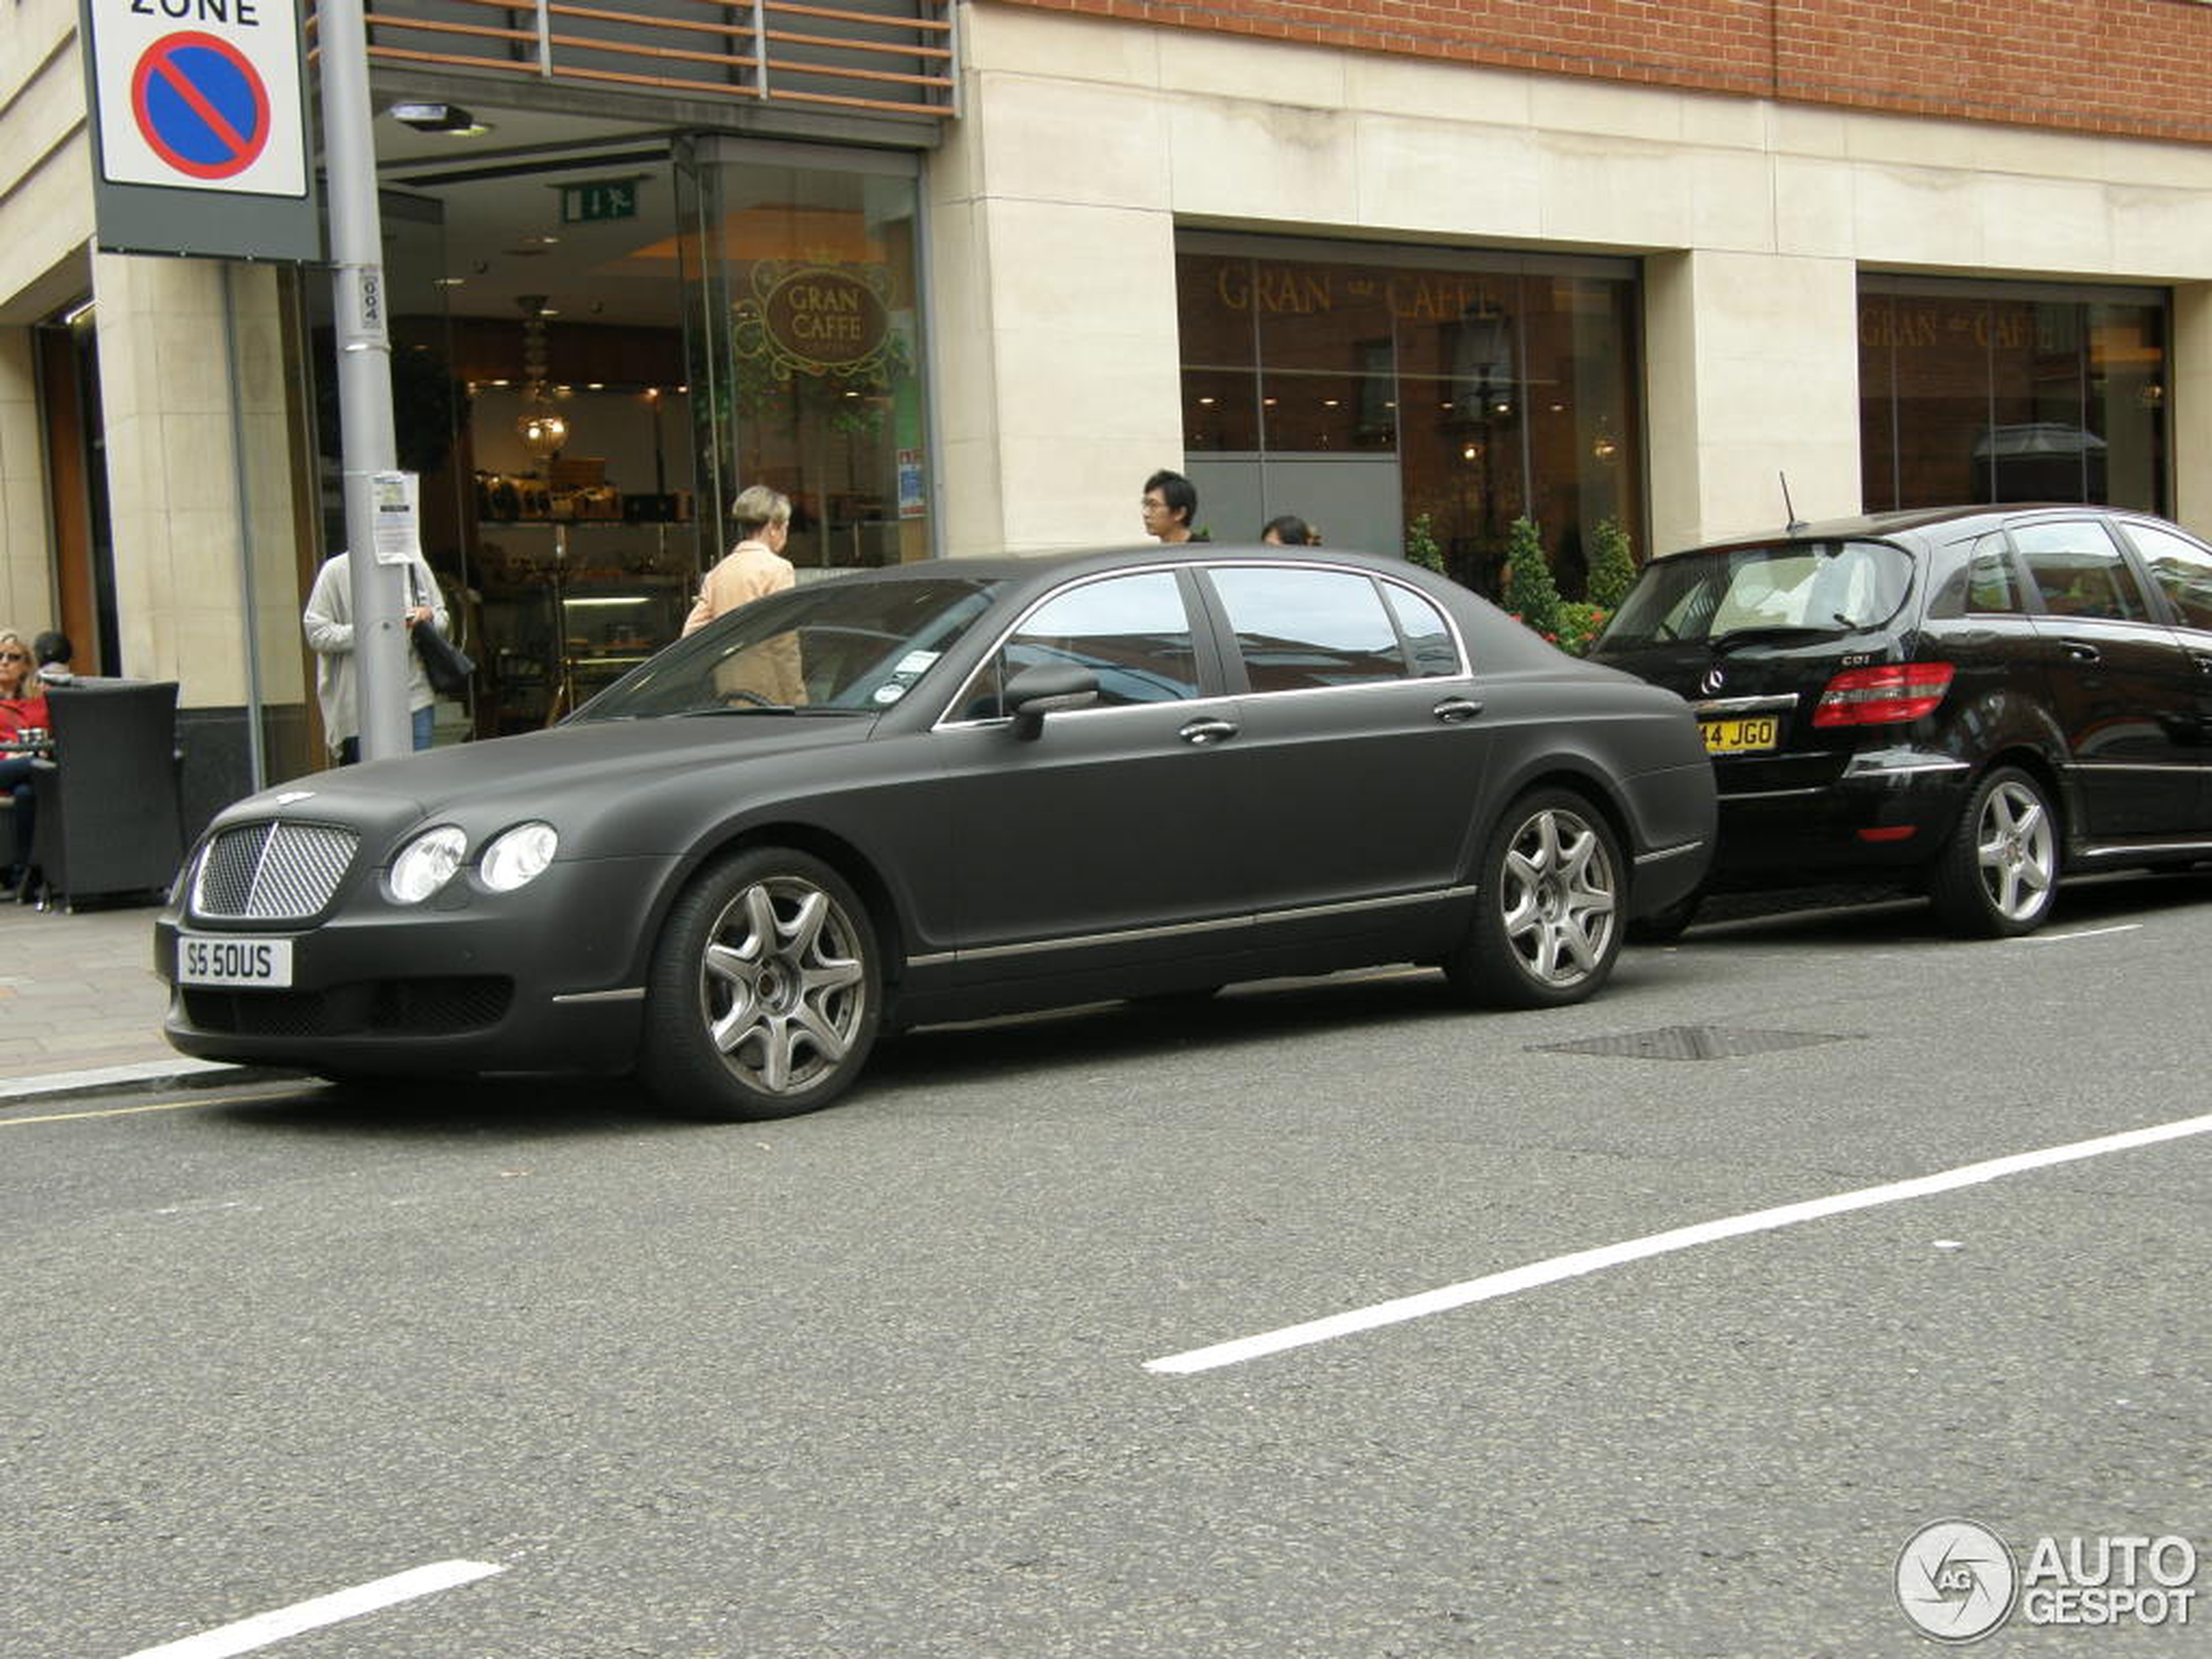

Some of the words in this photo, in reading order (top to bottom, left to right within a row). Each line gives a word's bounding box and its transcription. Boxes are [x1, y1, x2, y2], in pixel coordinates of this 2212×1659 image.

[789, 285, 859, 311] GRAN
[1218, 264, 1331, 312] GRAN
[792, 314, 860, 340] CAFFE
[1860, 308, 1937, 347] GRAN
[1730, 722, 1772, 745] JGO
